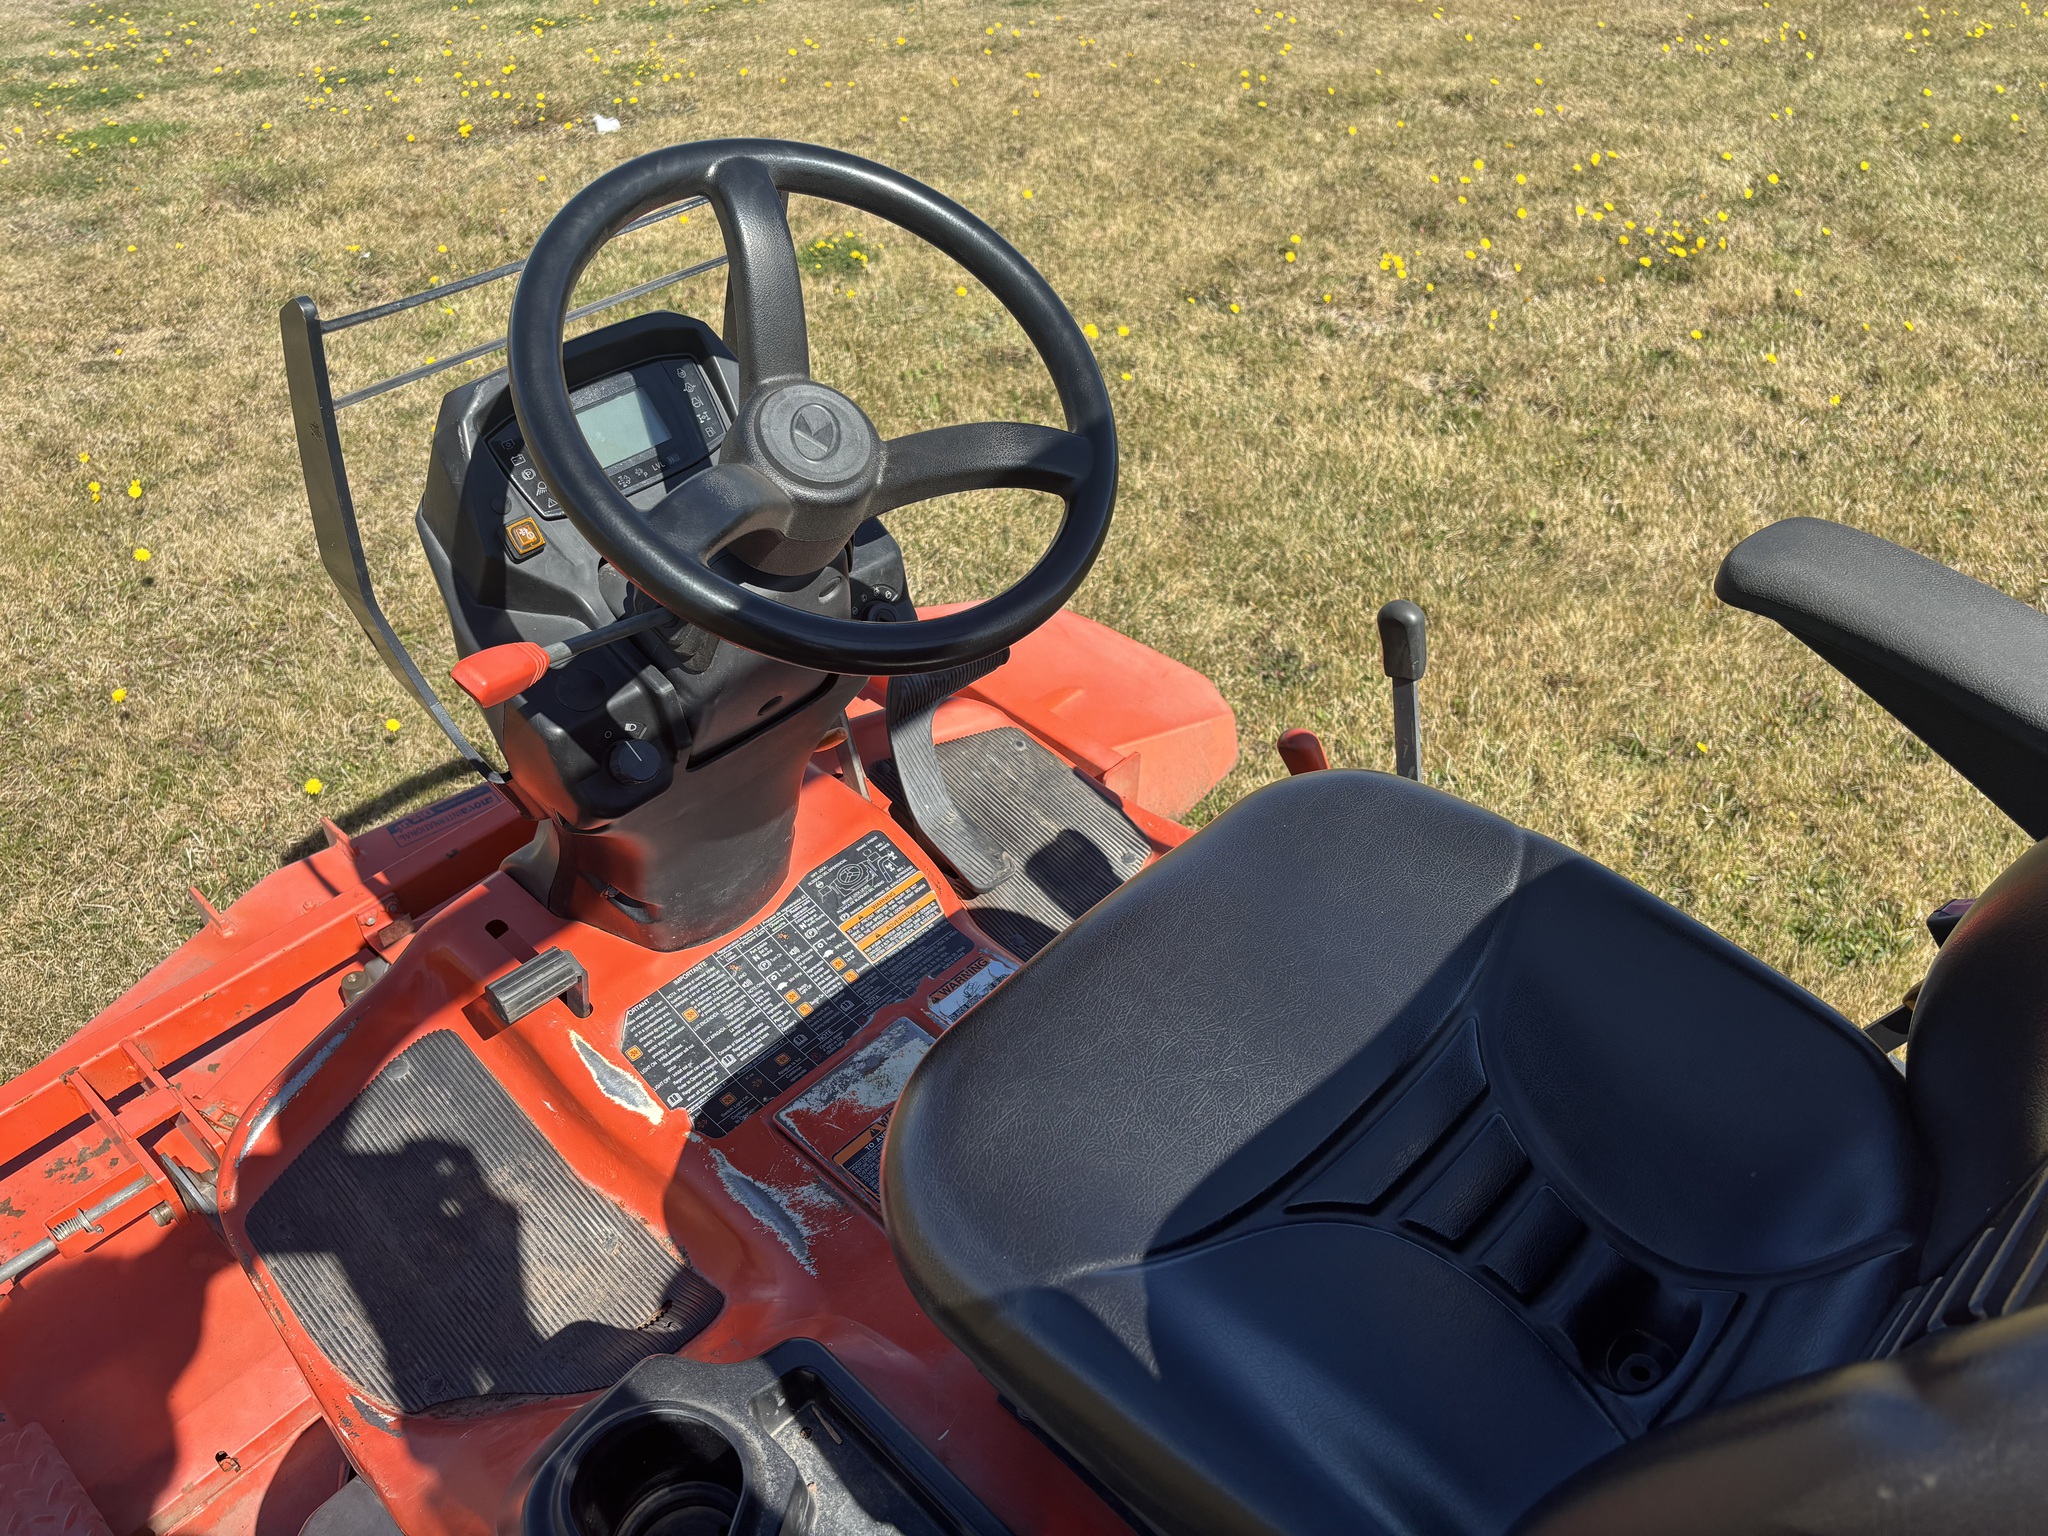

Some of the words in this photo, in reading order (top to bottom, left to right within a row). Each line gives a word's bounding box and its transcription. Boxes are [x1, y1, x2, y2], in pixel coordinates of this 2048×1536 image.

[652, 462, 666, 471] LVL
[870, 890, 896, 910] WARNING
[885, 903, 920, 930] ADVERTENCIA
[672, 960, 708, 985] IMPORTANTE
[940, 957, 989, 996] WARNING
[626, 997, 650, 1016] ORTANT
[865, 994, 880, 1006] NOTA
[817, 1029, 833, 1041] NOTE
[865, 1142, 874, 1150] TO
